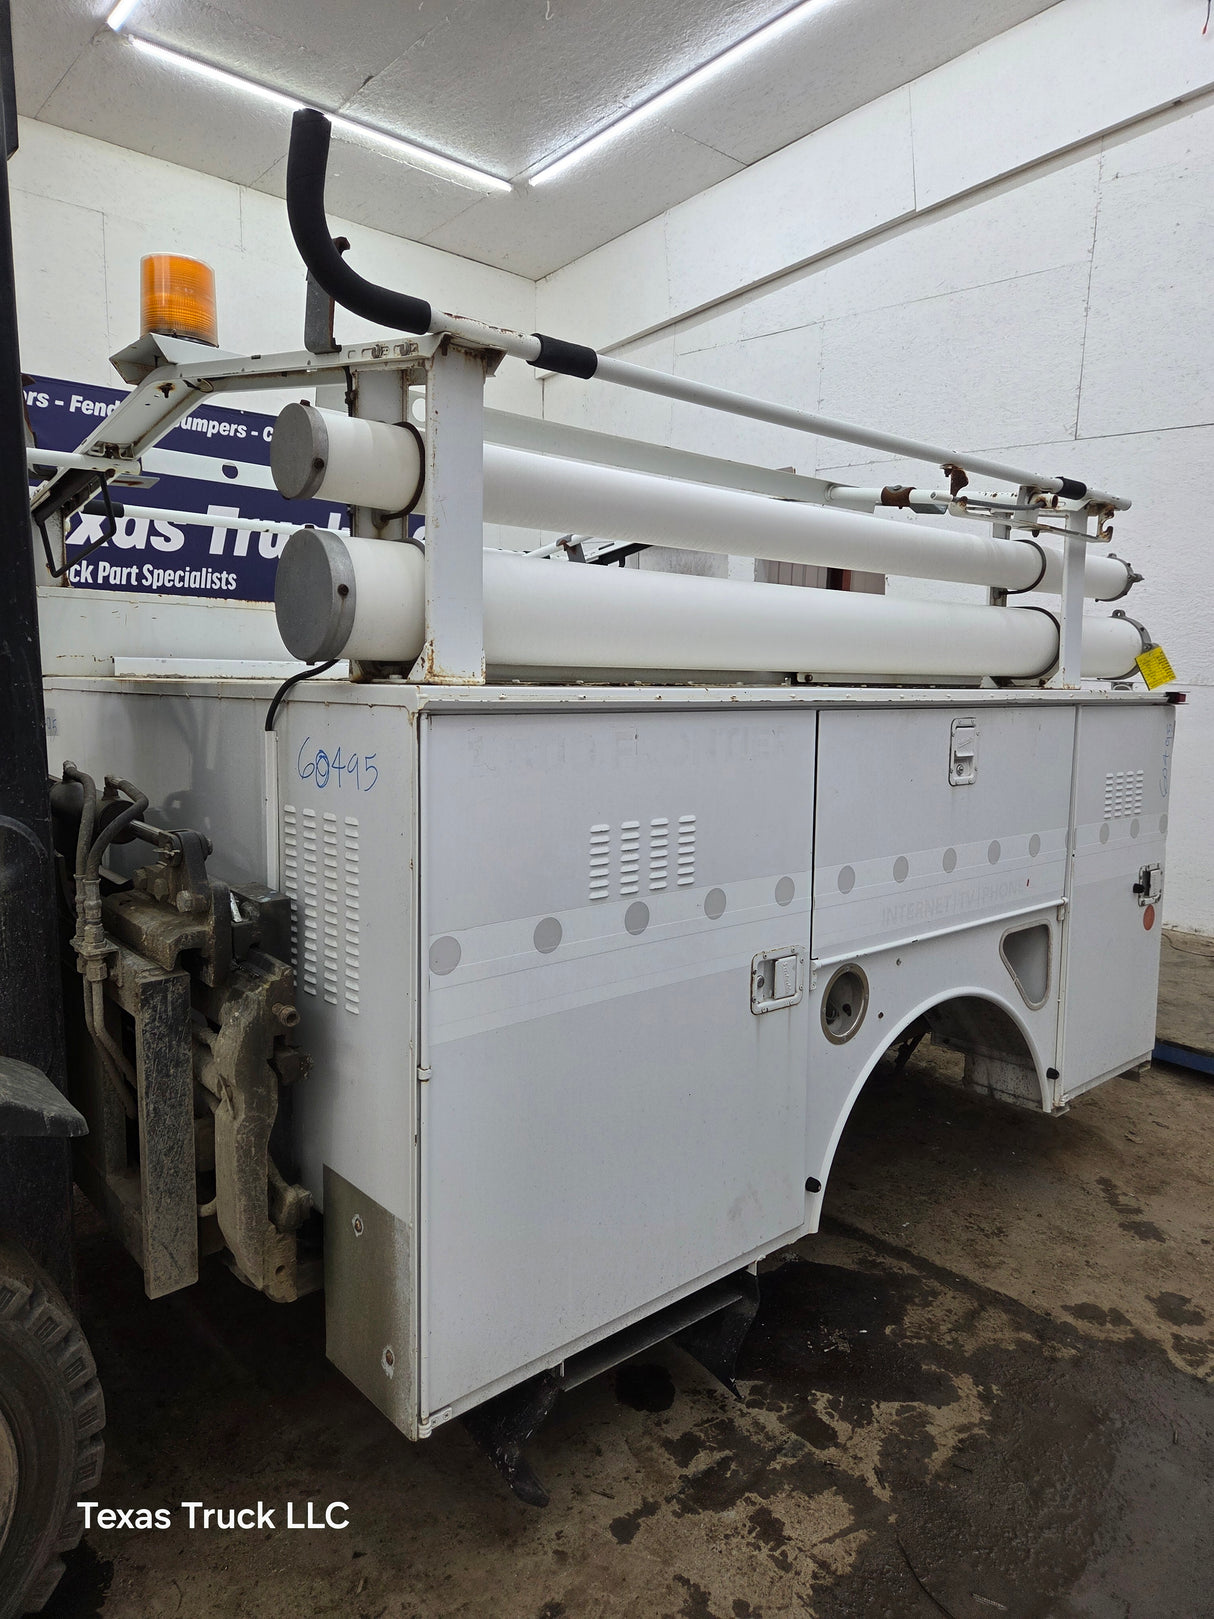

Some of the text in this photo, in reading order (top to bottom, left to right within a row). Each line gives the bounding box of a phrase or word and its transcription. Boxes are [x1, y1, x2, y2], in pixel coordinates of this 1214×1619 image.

[98, 561, 138, 586] Part
[142, 563, 237, 591] Specialists
[298, 737, 379, 792] 60495
[881, 895, 953, 927] INTERNET
